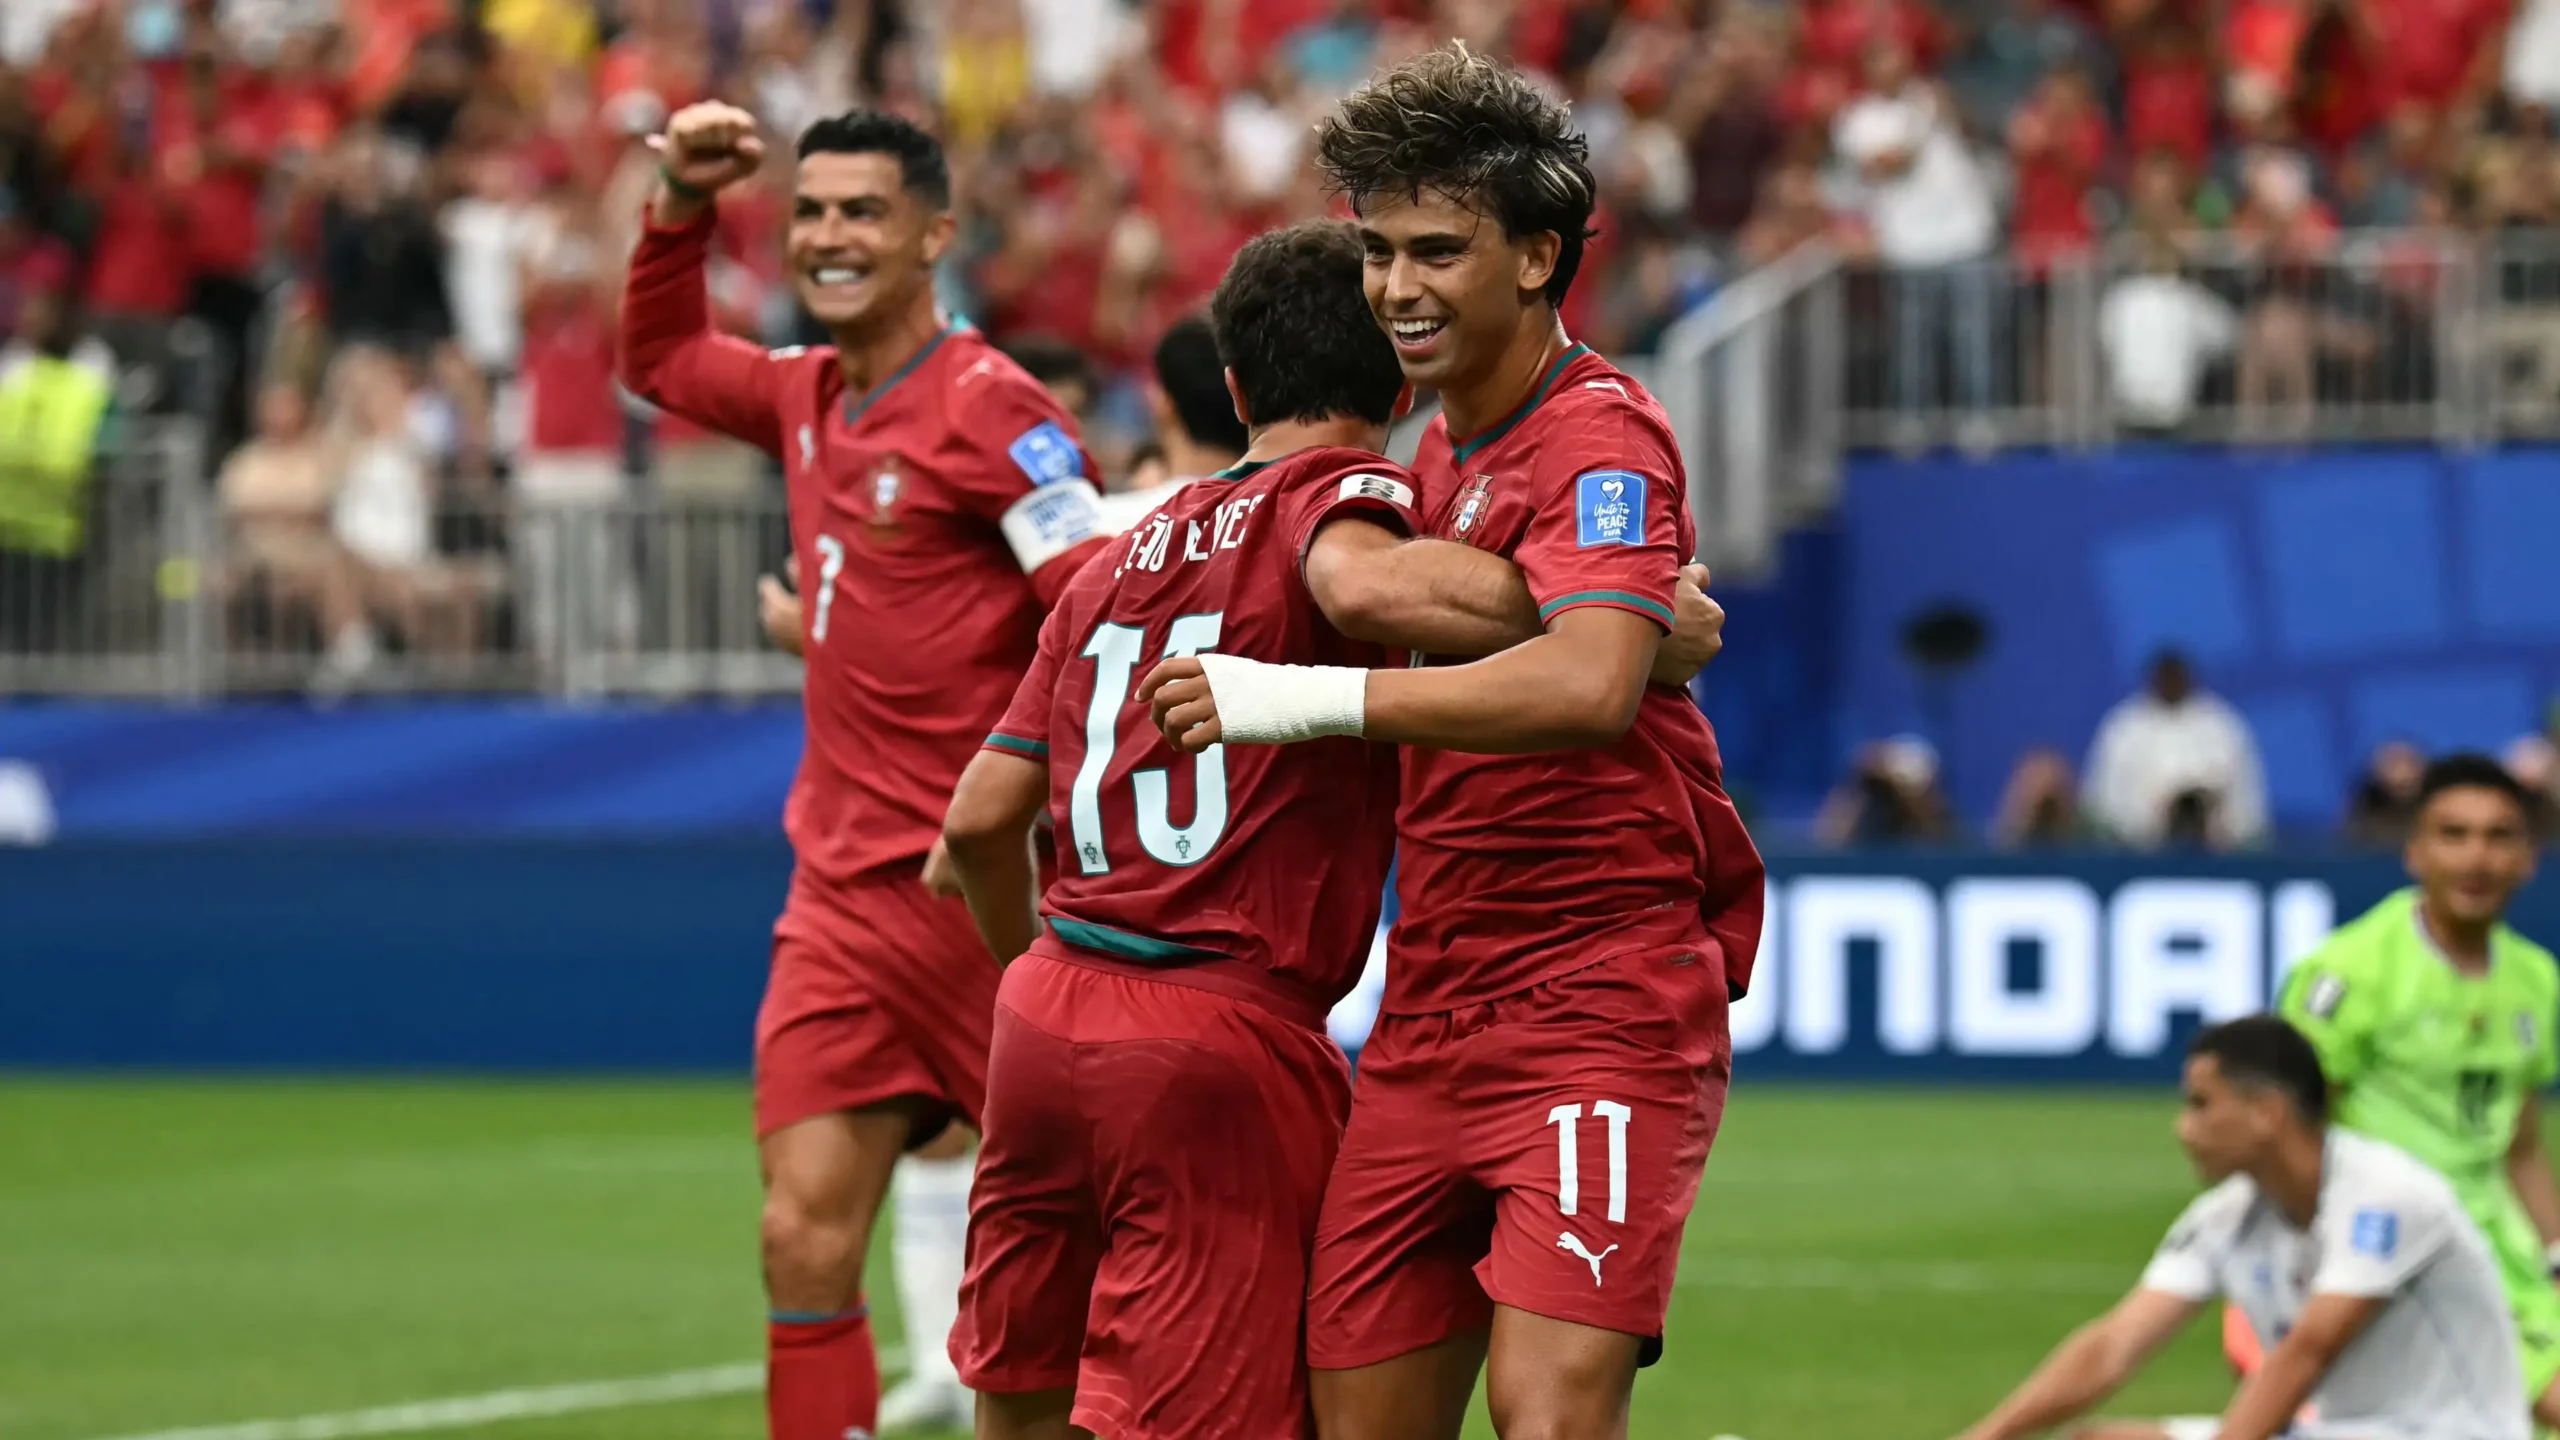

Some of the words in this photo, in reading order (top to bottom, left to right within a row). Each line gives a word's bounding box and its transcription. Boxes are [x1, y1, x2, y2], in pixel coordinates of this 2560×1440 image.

[1594, 502, 1618, 518] Unite
[1618, 503, 1631, 516] For
[1597, 514, 1628, 531] PEACE
[1603, 528, 1622, 538] FIFA
[812, 534, 844, 643] 7
[1070, 611, 1229, 876] 15
[1546, 1099, 1632, 1224] 11
